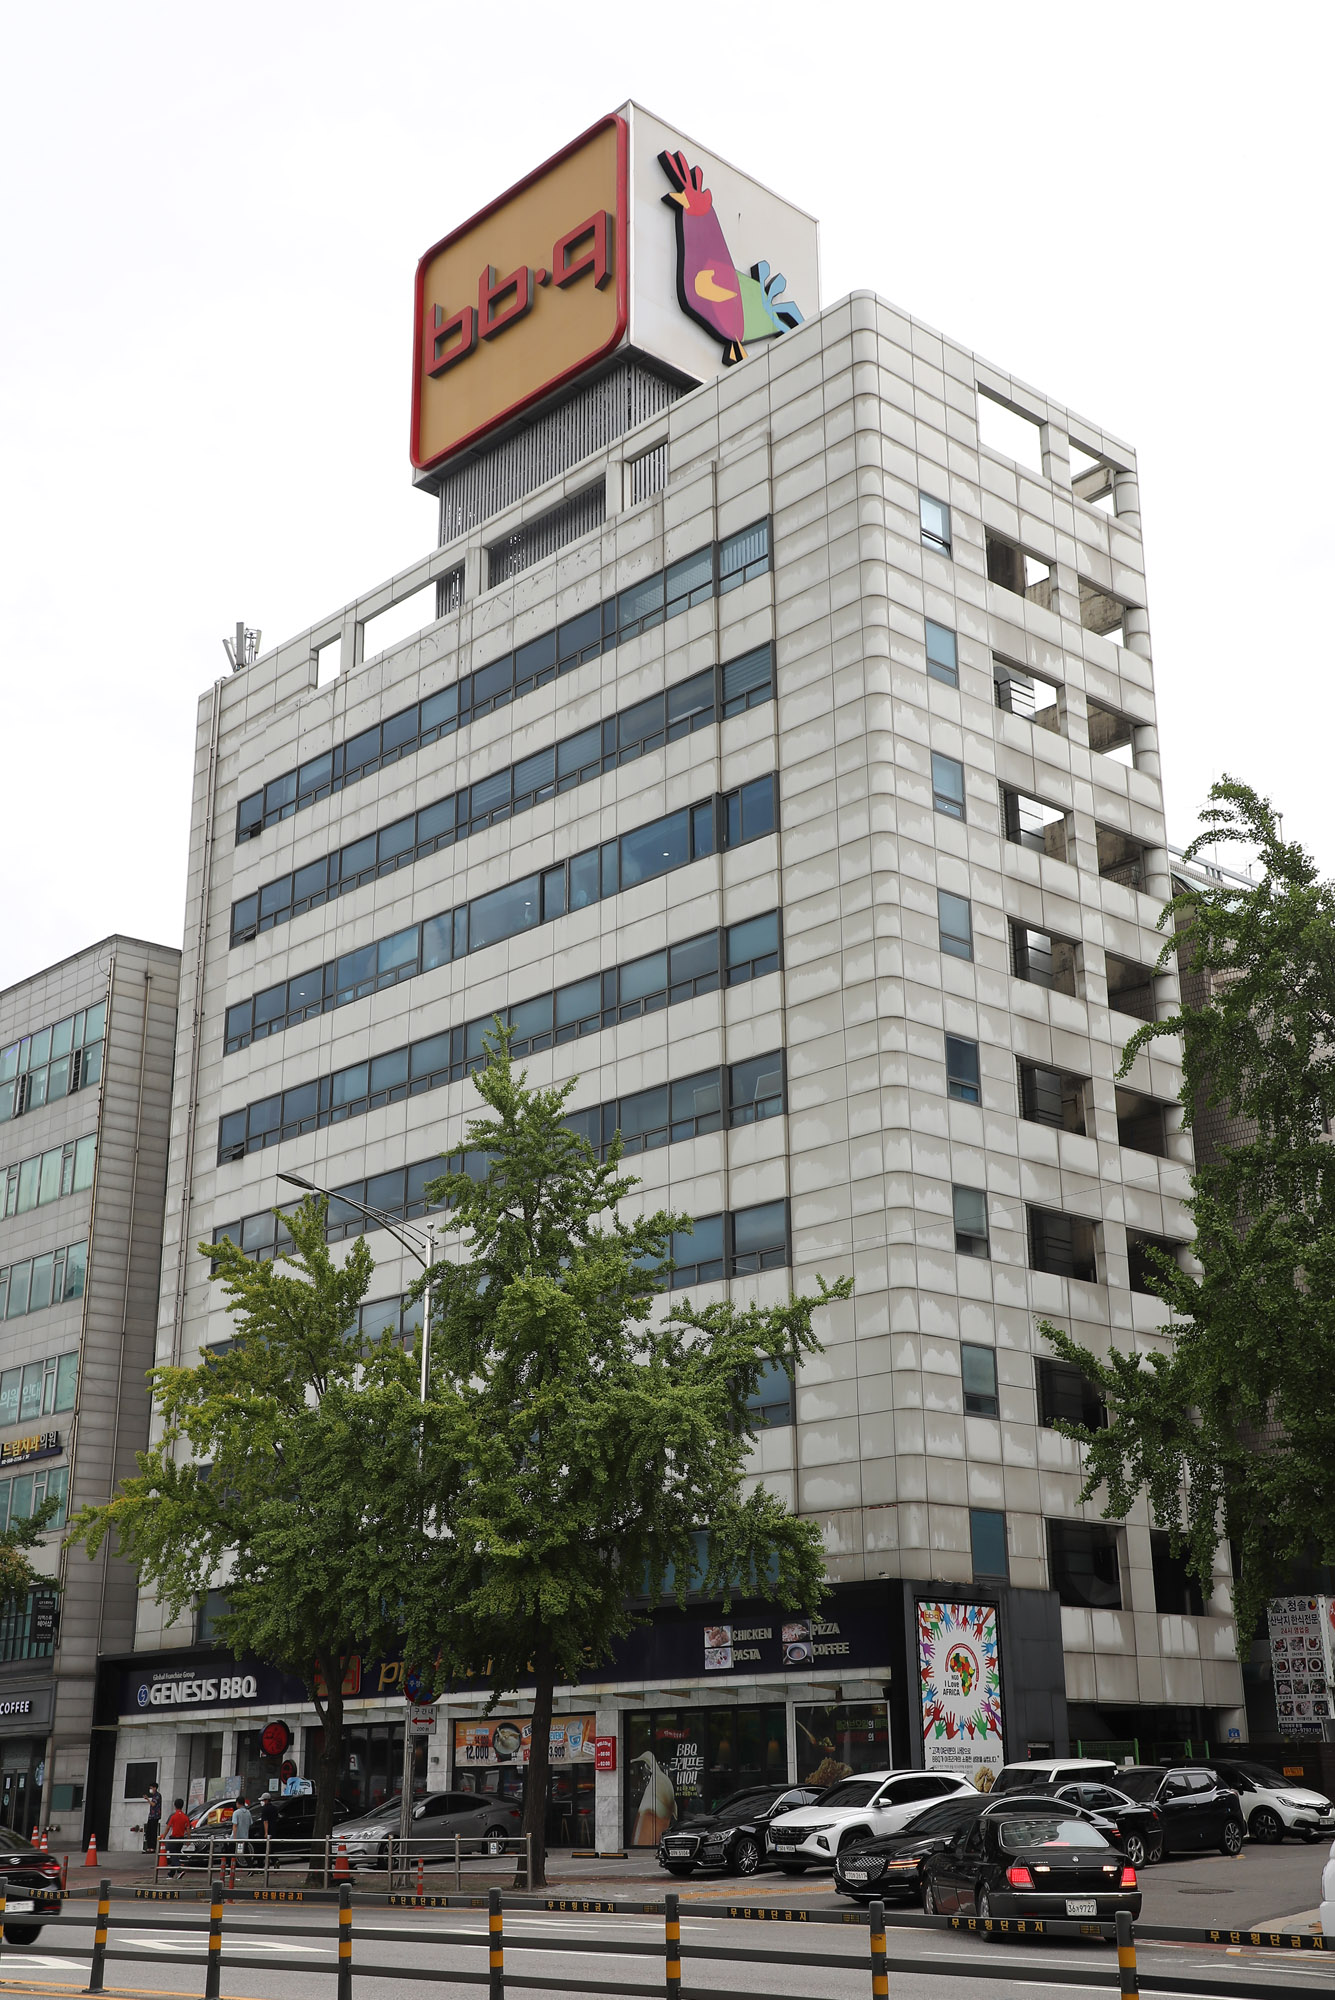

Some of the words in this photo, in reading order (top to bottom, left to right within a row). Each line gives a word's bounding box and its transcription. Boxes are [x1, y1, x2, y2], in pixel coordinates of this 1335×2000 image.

[2, 1431, 58, 1456] 드림치과의원
[1288, 1600, 1307, 1612] 청솔
[732, 1628, 772, 1641] CHICKEN
[812, 1622, 840, 1635] PIZZA
[732, 1648, 762, 1661] PASTA
[813, 1642, 850, 1656] COFFEE
[150, 1679, 218, 1705] GENESIS
[219, 1675, 258, 1700] BBQ
[0, 1700, 30, 1715] COFFEE
[414, 1707, 434, 1716] 구간내
[676, 1743, 698, 1756] BBQ
[669, 1756, 704, 1771] 크래프트
[676, 1771, 698, 1785] 비어!
[253, 1891, 304, 1902] 무단횡단금지
[390, 1896, 448, 1907] 무단횡단금지
[547, 1900, 615, 1913] 무단횡단금지
[730, 1907, 808, 1922] 무단횡단금지
[951, 1917, 1044, 1933] 무단횡단금지
[1210, 1930, 1323, 1950] 무단횡단금지
